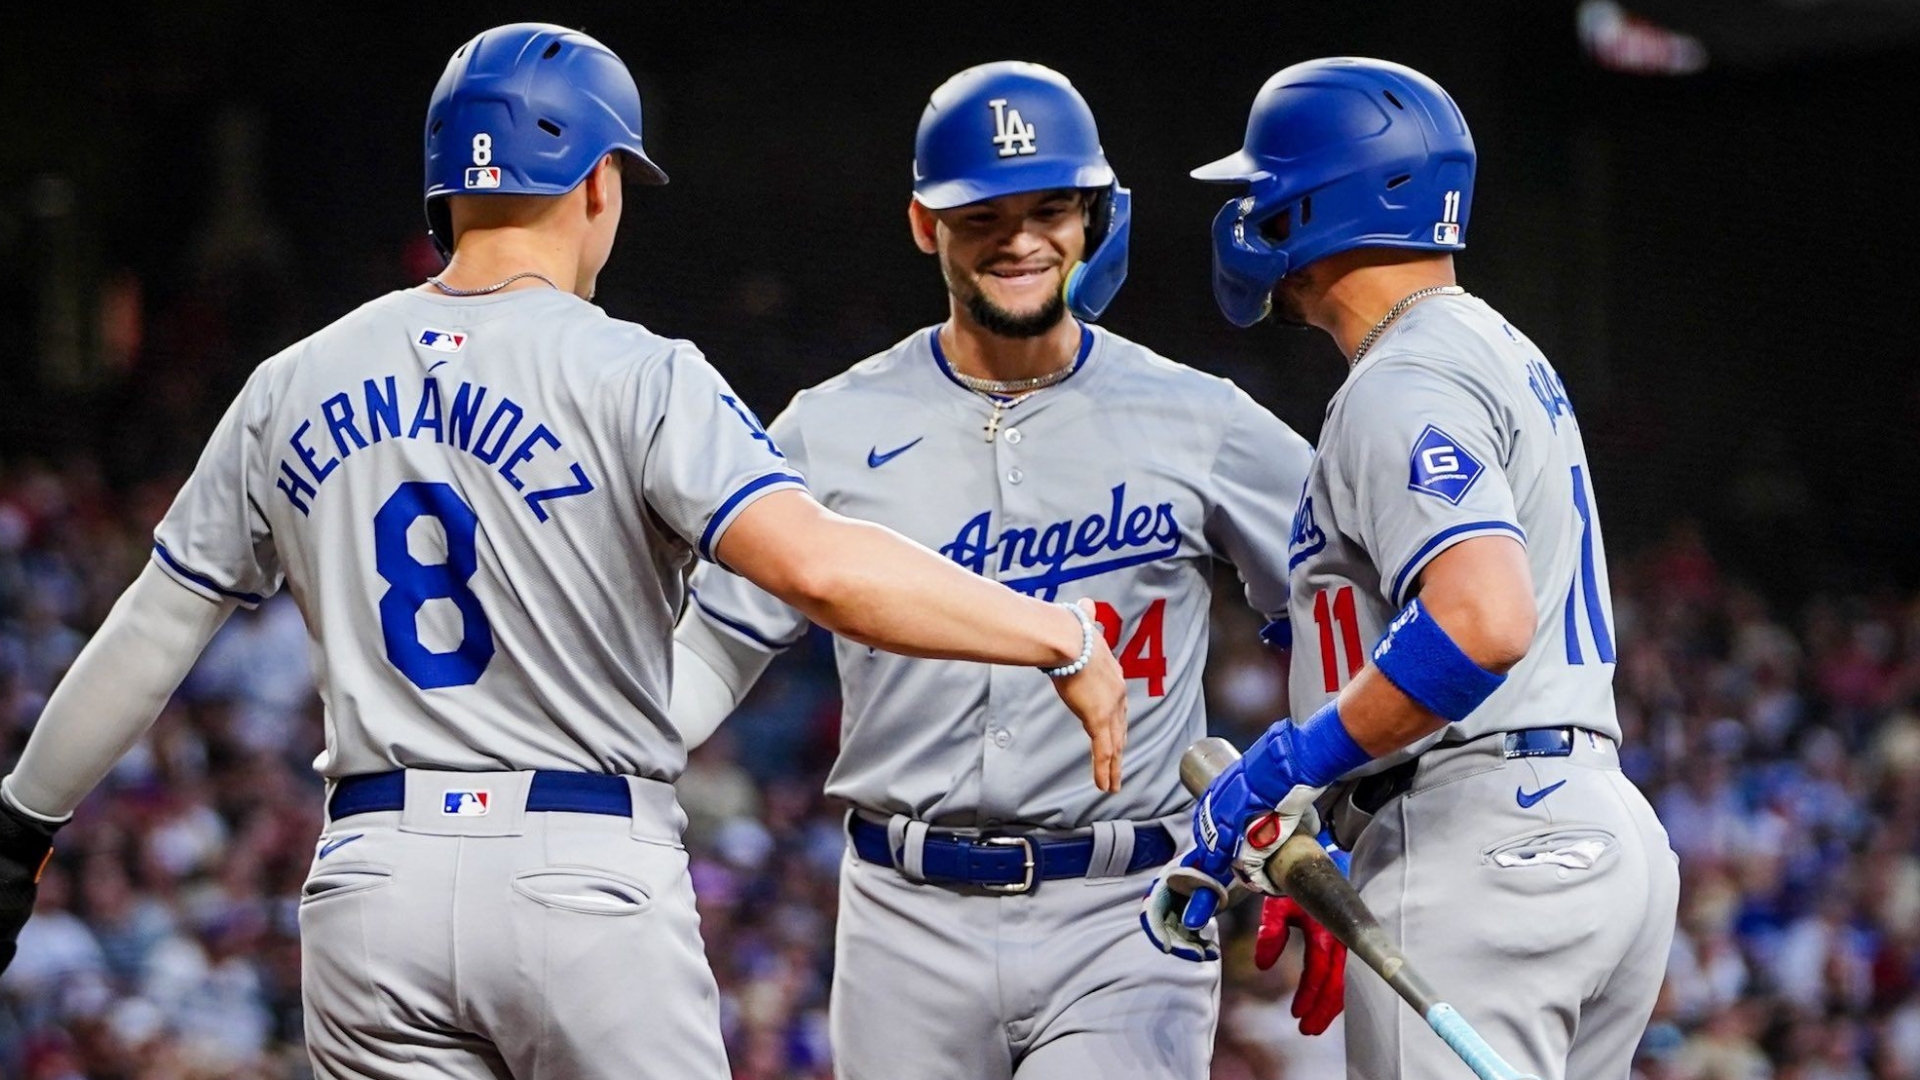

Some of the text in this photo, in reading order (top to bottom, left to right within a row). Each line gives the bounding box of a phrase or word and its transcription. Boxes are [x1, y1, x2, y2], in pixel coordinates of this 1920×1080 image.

[473, 133, 492, 166] 8
[989, 99, 1036, 156] LA
[1443, 190, 1460, 222] 11
[277, 361, 594, 523] HERNÁNDEZ
[1422, 446, 1459, 474] G
[939, 482, 1182, 603] Angeles
[374, 481, 496, 690] 8
[1314, 586, 1364, 693] 11
